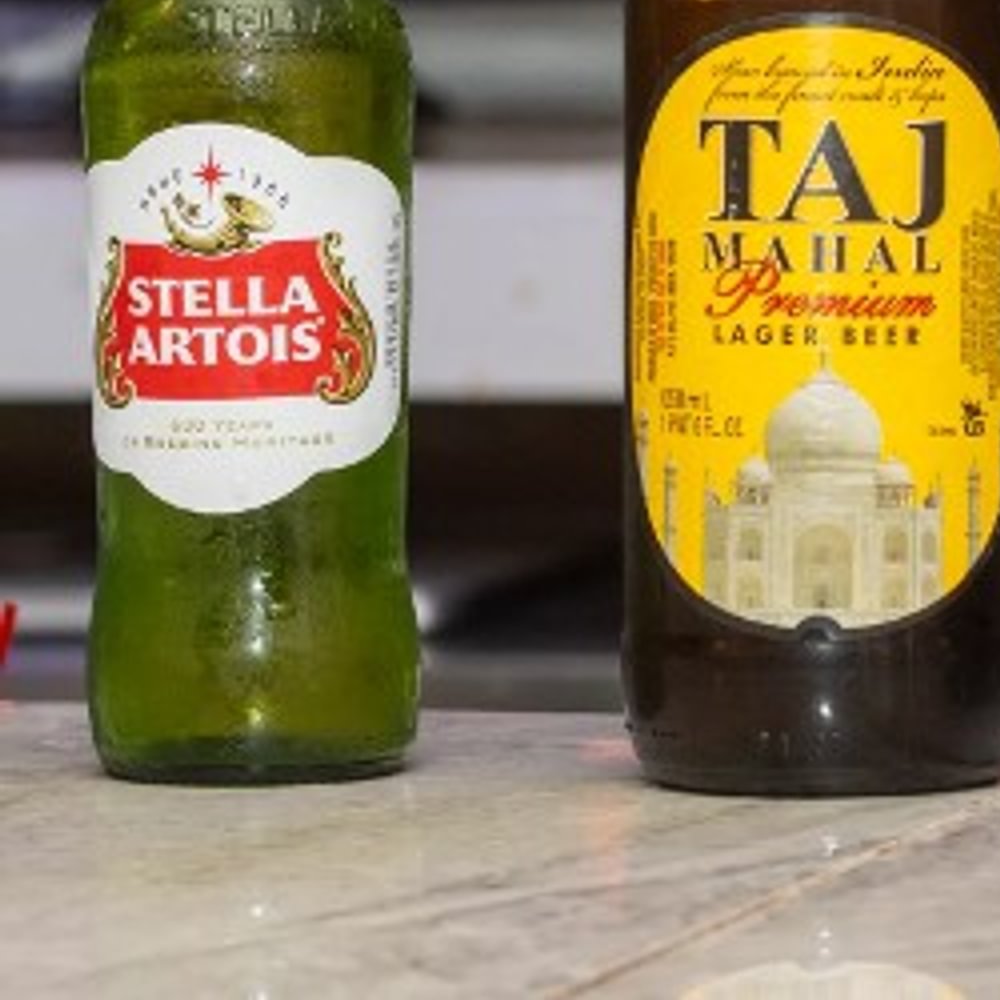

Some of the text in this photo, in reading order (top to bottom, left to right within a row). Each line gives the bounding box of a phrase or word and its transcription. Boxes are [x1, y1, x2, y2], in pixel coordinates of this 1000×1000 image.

[855, 55, 947, 80] India
[700, 119, 946, 233] TAJ
[703, 231, 943, 274] MAHAL
[128, 275, 320, 318] STELLA
[705, 256, 937, 318] Premium
[713, 324, 920, 346] LAGER BEER
